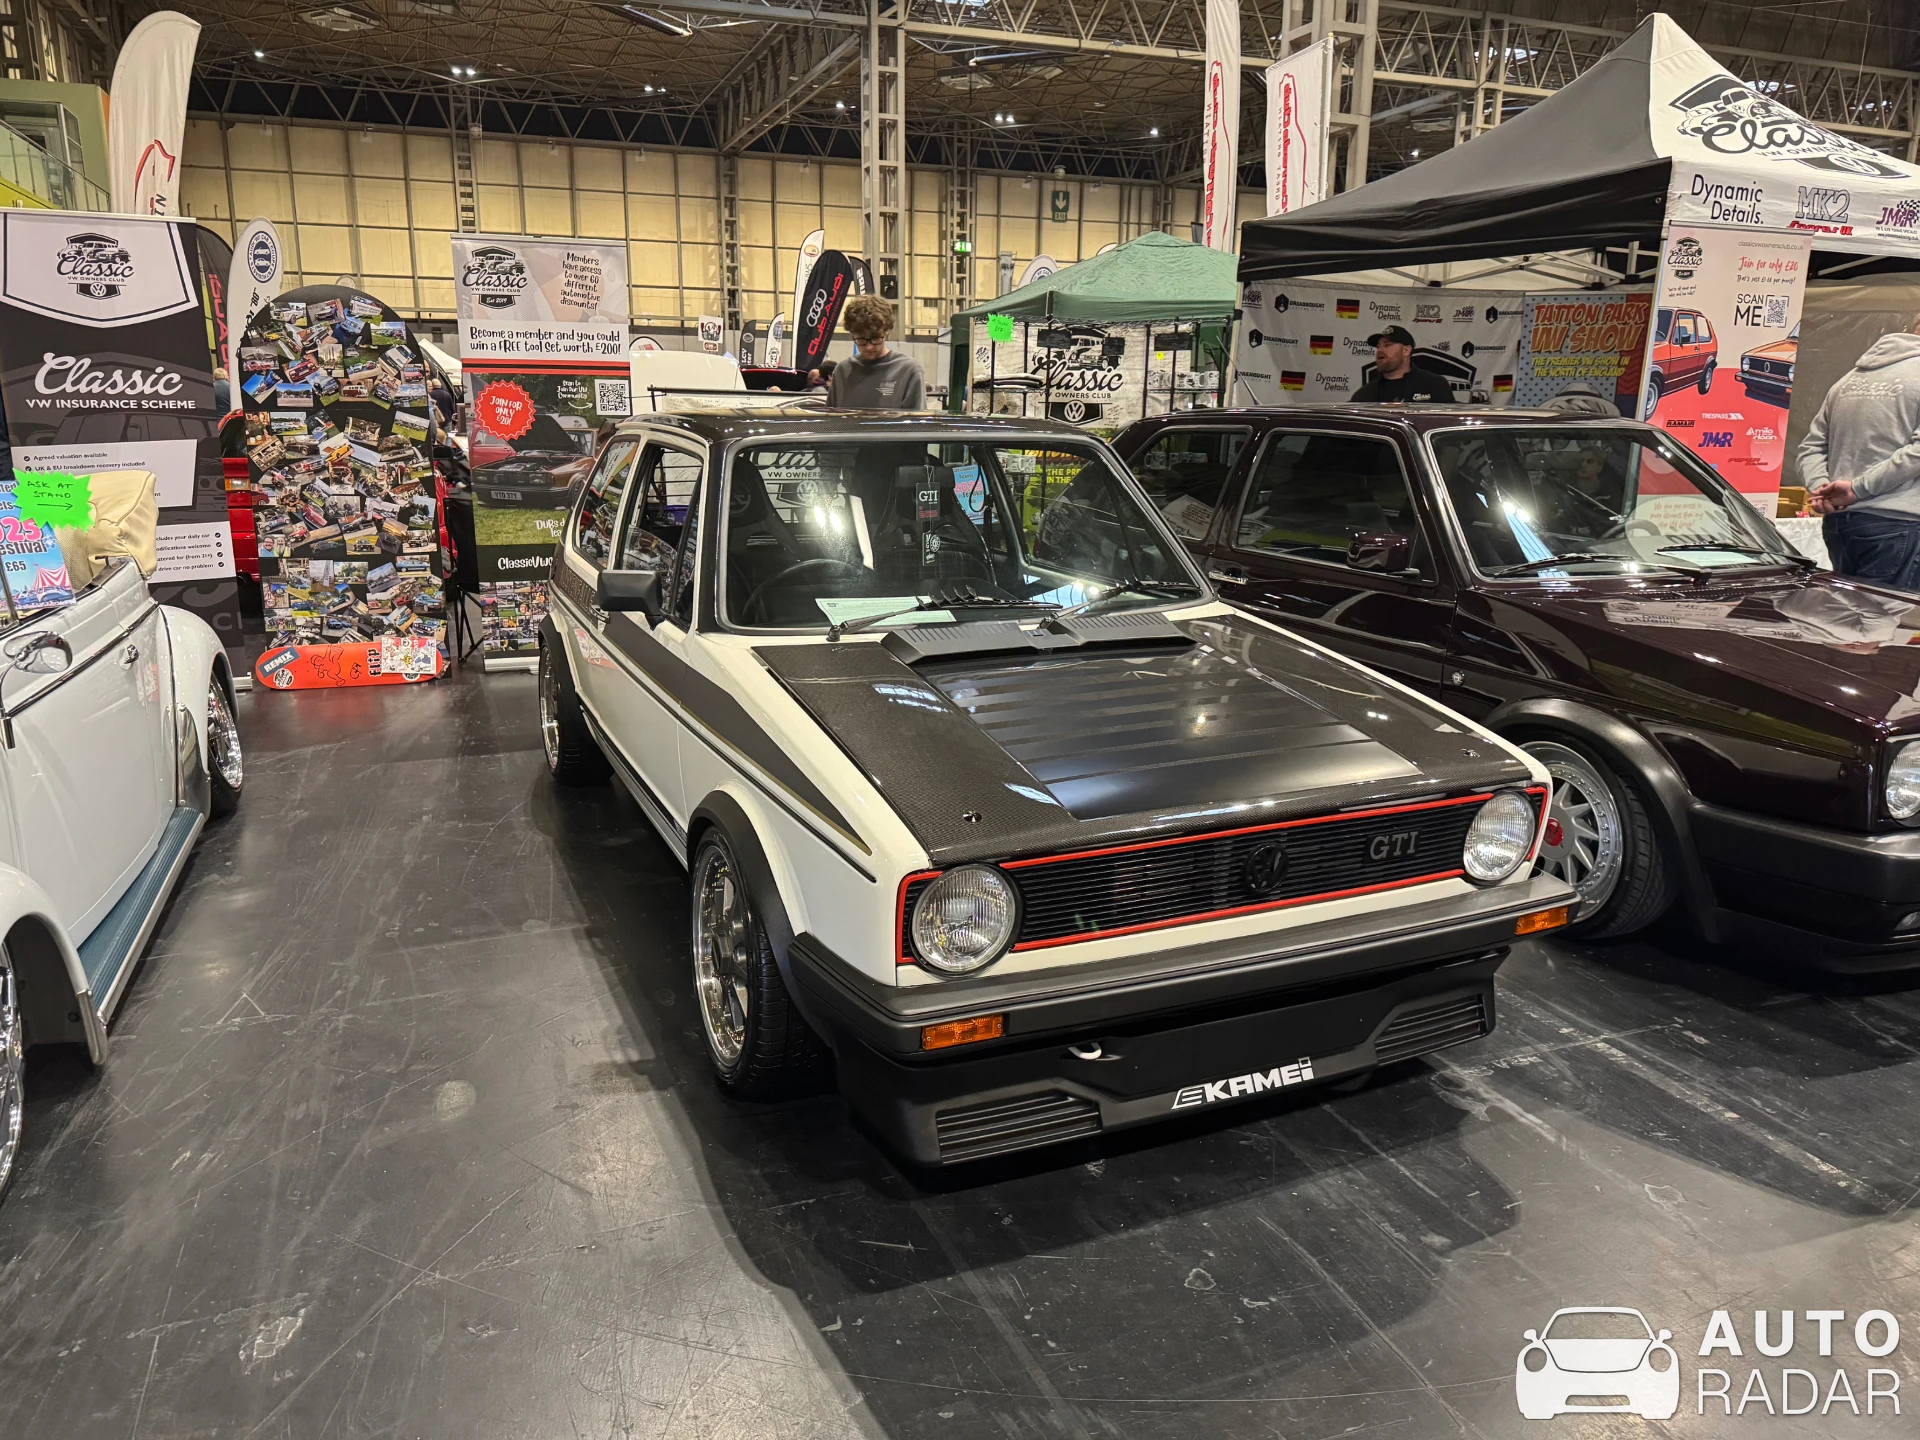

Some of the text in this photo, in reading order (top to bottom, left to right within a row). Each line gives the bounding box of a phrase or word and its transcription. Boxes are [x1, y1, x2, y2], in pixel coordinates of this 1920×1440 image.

[1691, 174, 1763, 204] Dynamic
[1710, 200, 1764, 225] Details.
[1795, 186, 1851, 224] MK2
[57, 253, 134, 278] Classic
[566, 252, 599, 266] Members
[1667, 250, 1703, 266] Classic
[1738, 256, 1754, 271] Join
[1757, 260, 1767, 270] for
[562, 260, 602, 275] have access
[462, 265, 528, 289] Classic
[564, 270, 572, 278] to
[573, 273, 588, 282] over
[564, 279, 597, 292] different
[560, 289, 601, 301] automotive
[1737, 293, 1764, 304] SCAN
[1369, 301, 1401, 313] Dynamic
[1533, 302, 1649, 326] TATTON PARK
[1734, 305, 1763, 326] ME
[470, 326, 620, 342] Become a member and you could
[1569, 323, 1644, 354] SHOW
[470, 341, 488, 351] win
[490, 342, 497, 351] a
[499, 340, 521, 353] FREE
[524, 341, 543, 353] tool
[563, 343, 593, 354] worth
[595, 342, 621, 355] £200!
[1533, 356, 1546, 366] THE
[1620, 356, 1630, 366] IN
[34, 352, 183, 396] Classic
[1315, 373, 1349, 386] Dynamic
[1534, 367, 1549, 377] THE
[1577, 367, 1589, 377] OF
[25, 399, 196, 409] VW INSURANCE SCHEME
[489, 396, 523, 411] JOIN FOR
[495, 408, 515, 418] ONLY
[918, 490, 938, 502] GTI
[4, 560, 27, 572] £65
[264, 650, 295, 673] REMIX
[1368, 831, 1419, 860] GTI
